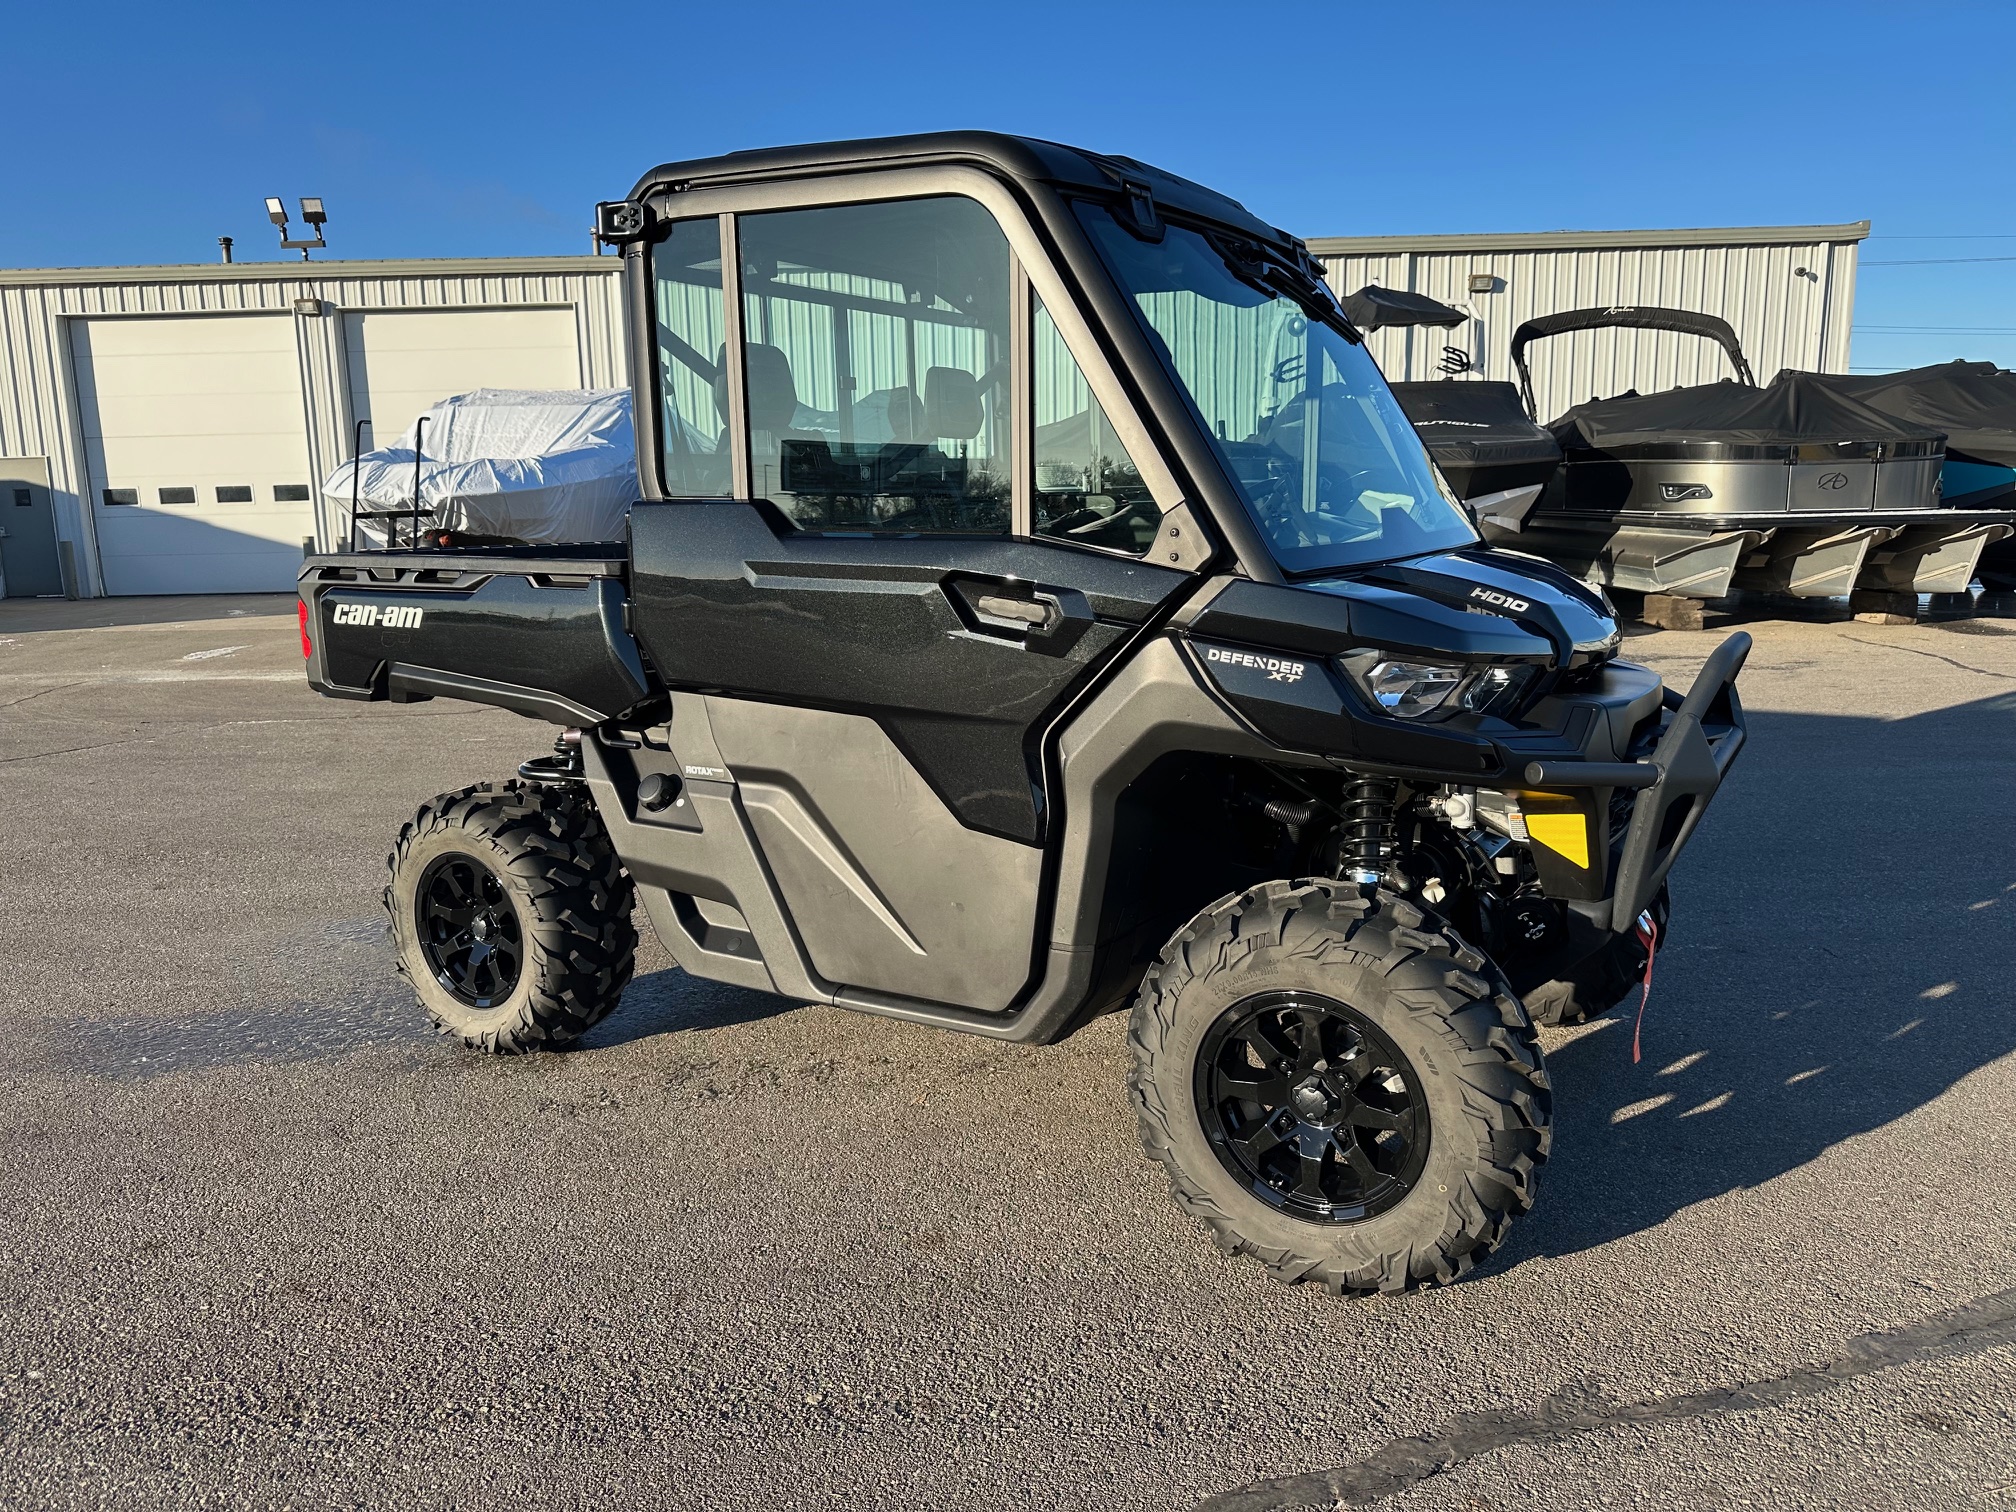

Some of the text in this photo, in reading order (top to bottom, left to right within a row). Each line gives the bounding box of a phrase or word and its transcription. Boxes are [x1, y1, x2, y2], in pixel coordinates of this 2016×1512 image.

[1413, 420, 1491, 428] AUTIQUE
[1470, 587, 1530, 612] HD10
[333, 604, 424, 629] can-am
[1207, 648, 1305, 676] DEFENDER
[1267, 671, 1302, 683] XT
[685, 765, 714, 776] ROTAX
[1175, 1015, 1200, 1062] KING
